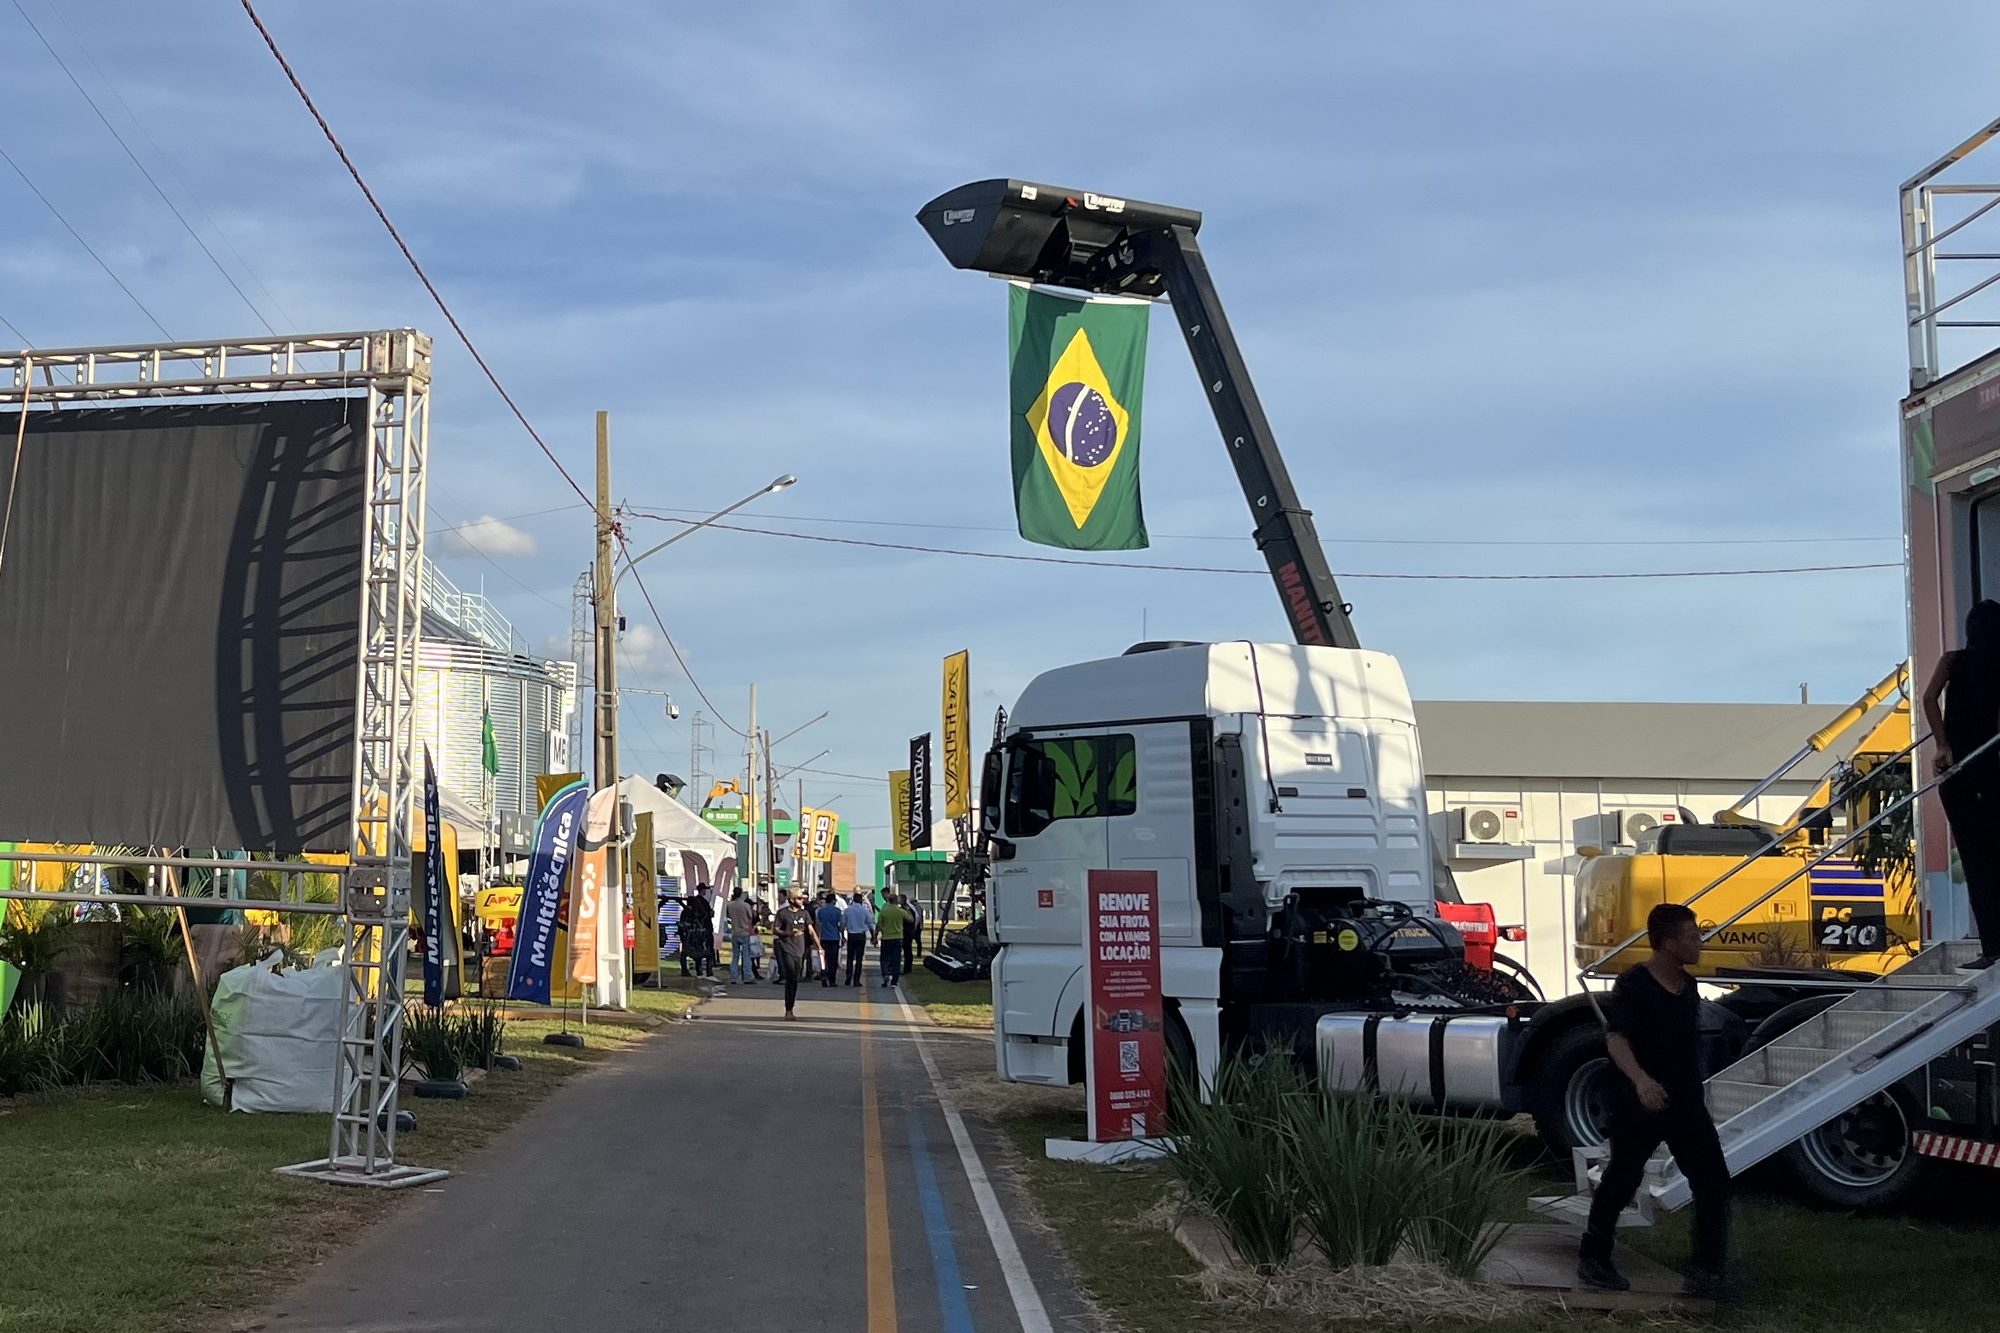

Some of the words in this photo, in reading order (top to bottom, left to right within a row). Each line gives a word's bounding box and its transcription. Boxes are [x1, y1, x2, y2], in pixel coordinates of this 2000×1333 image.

[1191, 325, 1200, 337] A
[1234, 436, 1244, 448] C
[1257, 495, 1267, 507] D
[814, 816, 829, 857] JCB
[1099, 893, 1150, 911] RENOVE
[1822, 906, 1853, 922] PC
[1099, 915, 1119, 928] SUA
[1120, 915, 1150, 928] FROTA
[1100, 931, 1117, 942] COM
[1118, 931, 1124, 942] A
[1124, 931, 1150, 942] VAMOS
[1718, 931, 1777, 945] VAMO
[1821, 924, 1877, 946] 210
[1100, 942, 1151, 963] LOCAÇÃO!
